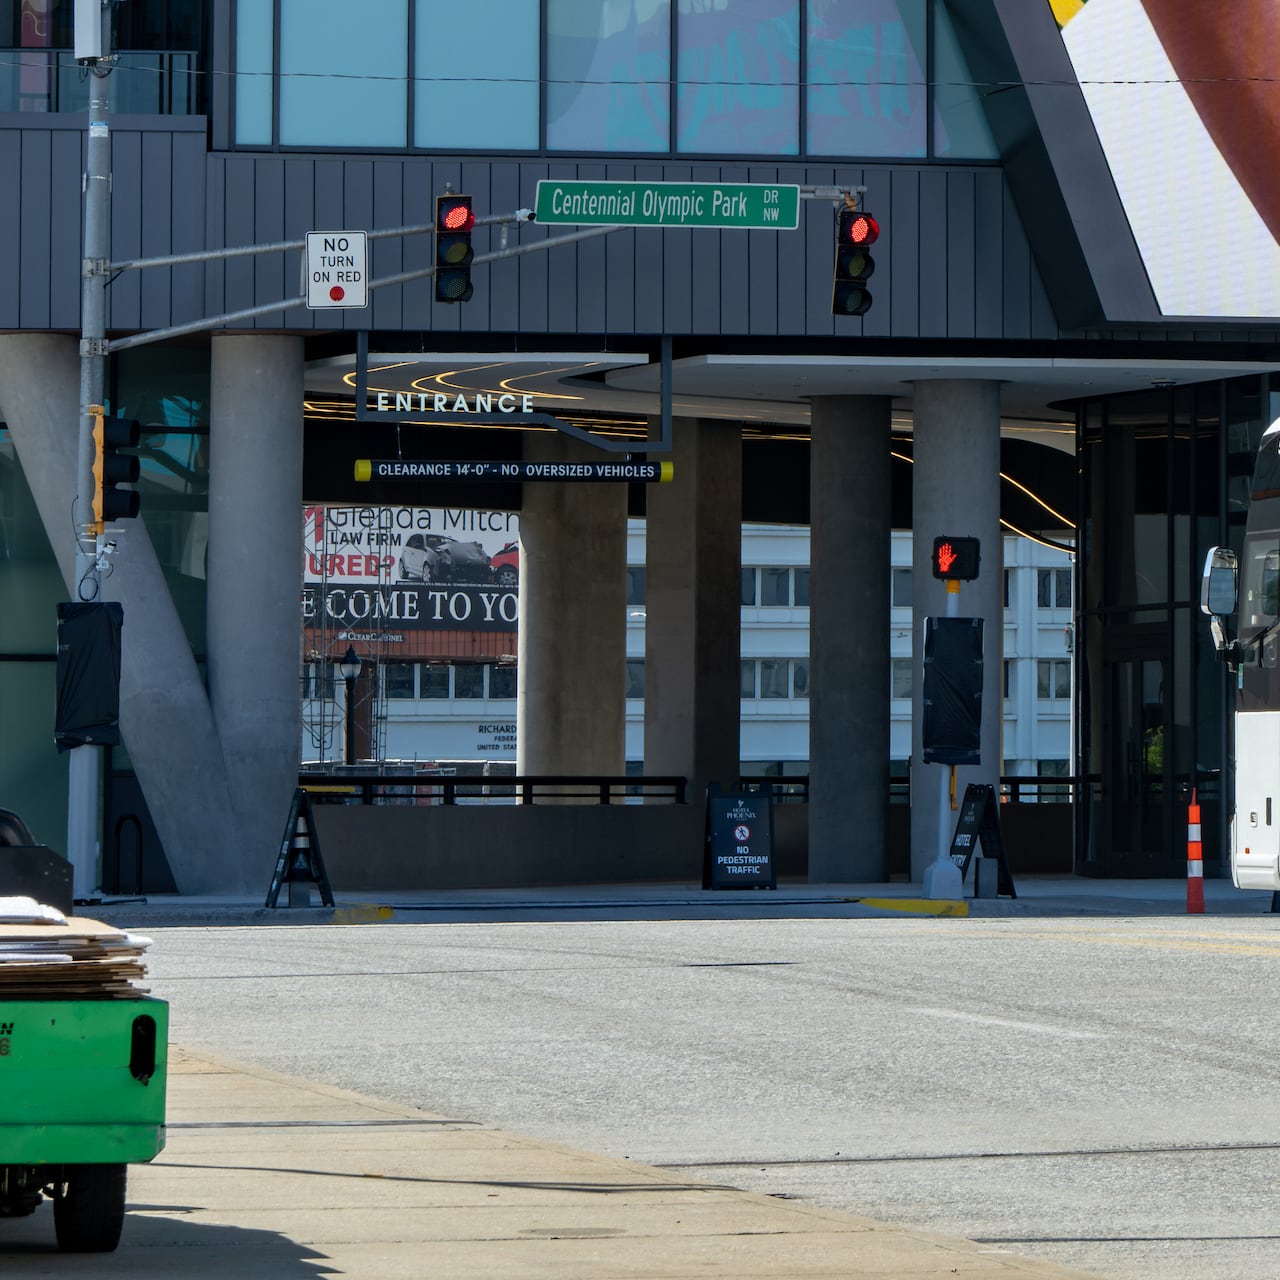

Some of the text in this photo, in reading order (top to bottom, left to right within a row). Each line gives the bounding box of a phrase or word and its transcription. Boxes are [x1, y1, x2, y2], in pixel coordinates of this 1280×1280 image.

[763, 190, 779, 204] DR
[552, 188, 747, 223] Centennial Olympic Park
[763, 208, 780, 222] NW
[324, 238, 349, 252] NO
[320, 256, 354, 267] TURN
[313, 271, 361, 282] ON RED
[377, 393, 534, 413] ENTRANCE
[378, 463, 451, 476] CLEARANCE
[502, 464, 519, 476] NO
[526, 464, 593, 477] OVERSIZED
[596, 465, 655, 478] VEHICLES
[327, 507, 431, 529] Glenda
[331, 532, 401, 546] LAW FIRM
[304, 554, 396, 577] URED?
[326, 589, 420, 619] COME
[429, 591, 472, 620] TO
[478, 724, 517, 734] RICHARD
[736, 846, 749, 854] NO
[717, 856, 768, 864] PEDESTRIAN
[727, 866, 760, 874] TRAFFIC
